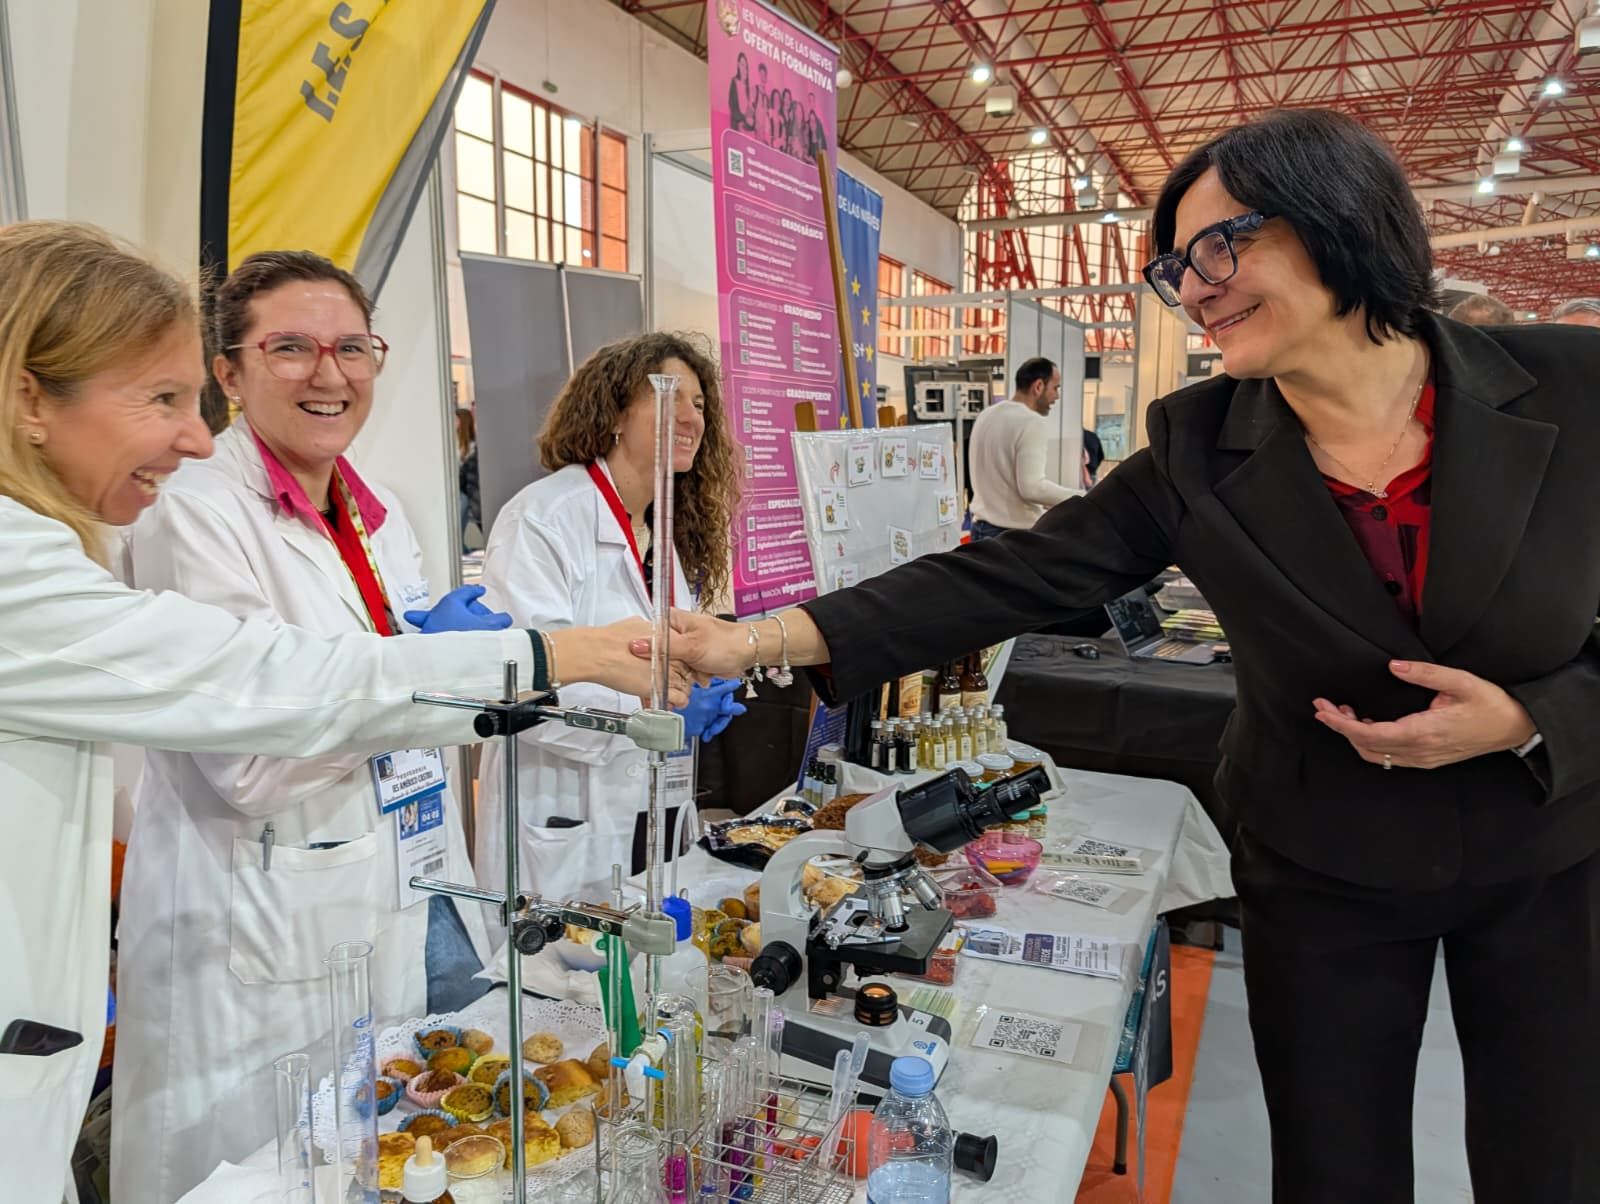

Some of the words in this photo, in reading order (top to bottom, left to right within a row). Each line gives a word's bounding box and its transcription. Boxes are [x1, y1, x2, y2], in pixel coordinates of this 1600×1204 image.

[742, 7, 754, 25] IES
[755, 15, 785, 43] VIRGEN
[785, 33, 795, 50] DE
[795, 40, 809, 58] LAS
[809, 48, 833, 73] NIEVES
[743, 28, 781, 63] OFERTA
[781, 50, 833, 93] FORMATIVA
[847, 200, 860, 219] LAS
